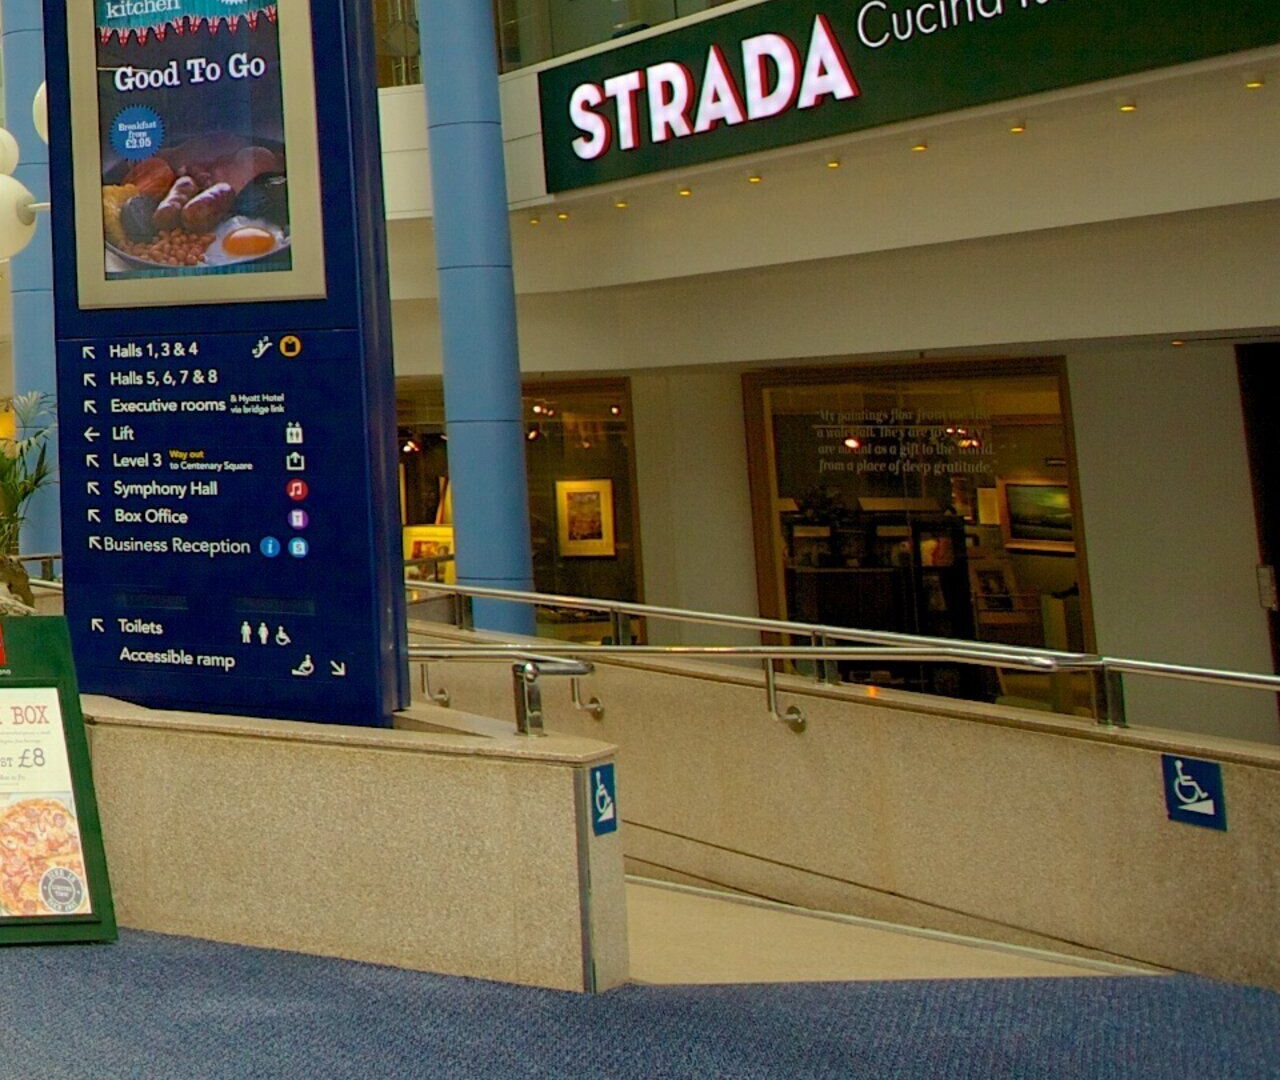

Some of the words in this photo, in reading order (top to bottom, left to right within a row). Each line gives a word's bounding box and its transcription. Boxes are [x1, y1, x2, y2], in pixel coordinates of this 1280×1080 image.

[114, 62, 180, 93] Good
[186, 58, 221, 84] To
[228, 53, 266, 80] Go
[568, 13, 860, 161] STRADA
[118, 121, 157, 132] Breakfast
[109, 343, 143, 358] Halls
[161, 343, 171, 358] 3
[173, 342, 187, 357] &
[188, 342, 199, 357] 4
[110, 370, 143, 386] Halls
[146, 371, 160, 387] 5,
[162, 371, 177, 387] 6,
[179, 370, 189, 385] 7
[191, 370, 206, 384] &
[207, 369, 218, 384] 8
[110, 398, 178, 413] Executive
[181, 399, 226, 412] rooms
[239, 392, 260, 404] Hyatt
[262, 392, 284, 403] Hotel
[243, 404, 268, 415] bridge
[270, 404, 284, 414] link
[112, 425, 134, 441] Lift
[112, 452, 150, 468] Level
[152, 452, 162, 467] 3
[169, 449, 187, 461] Way
[189, 450, 204, 459] out
[169, 461, 179, 470] to
[180, 460, 222, 472] Centenary
[223, 460, 253, 471] Square
[113, 480, 187, 499] Symphony
[190, 480, 218, 496] Hall
[115, 509, 142, 524] Box
[145, 508, 188, 524] Office
[104, 537, 168, 552] Business
[172, 538, 251, 557] Reception
[118, 619, 163, 635] Toilets
[120, 647, 193, 665] Accessible
[196, 652, 235, 671] ramp
[10, 705, 50, 726] BOX
[18, 747, 46, 769] £8
